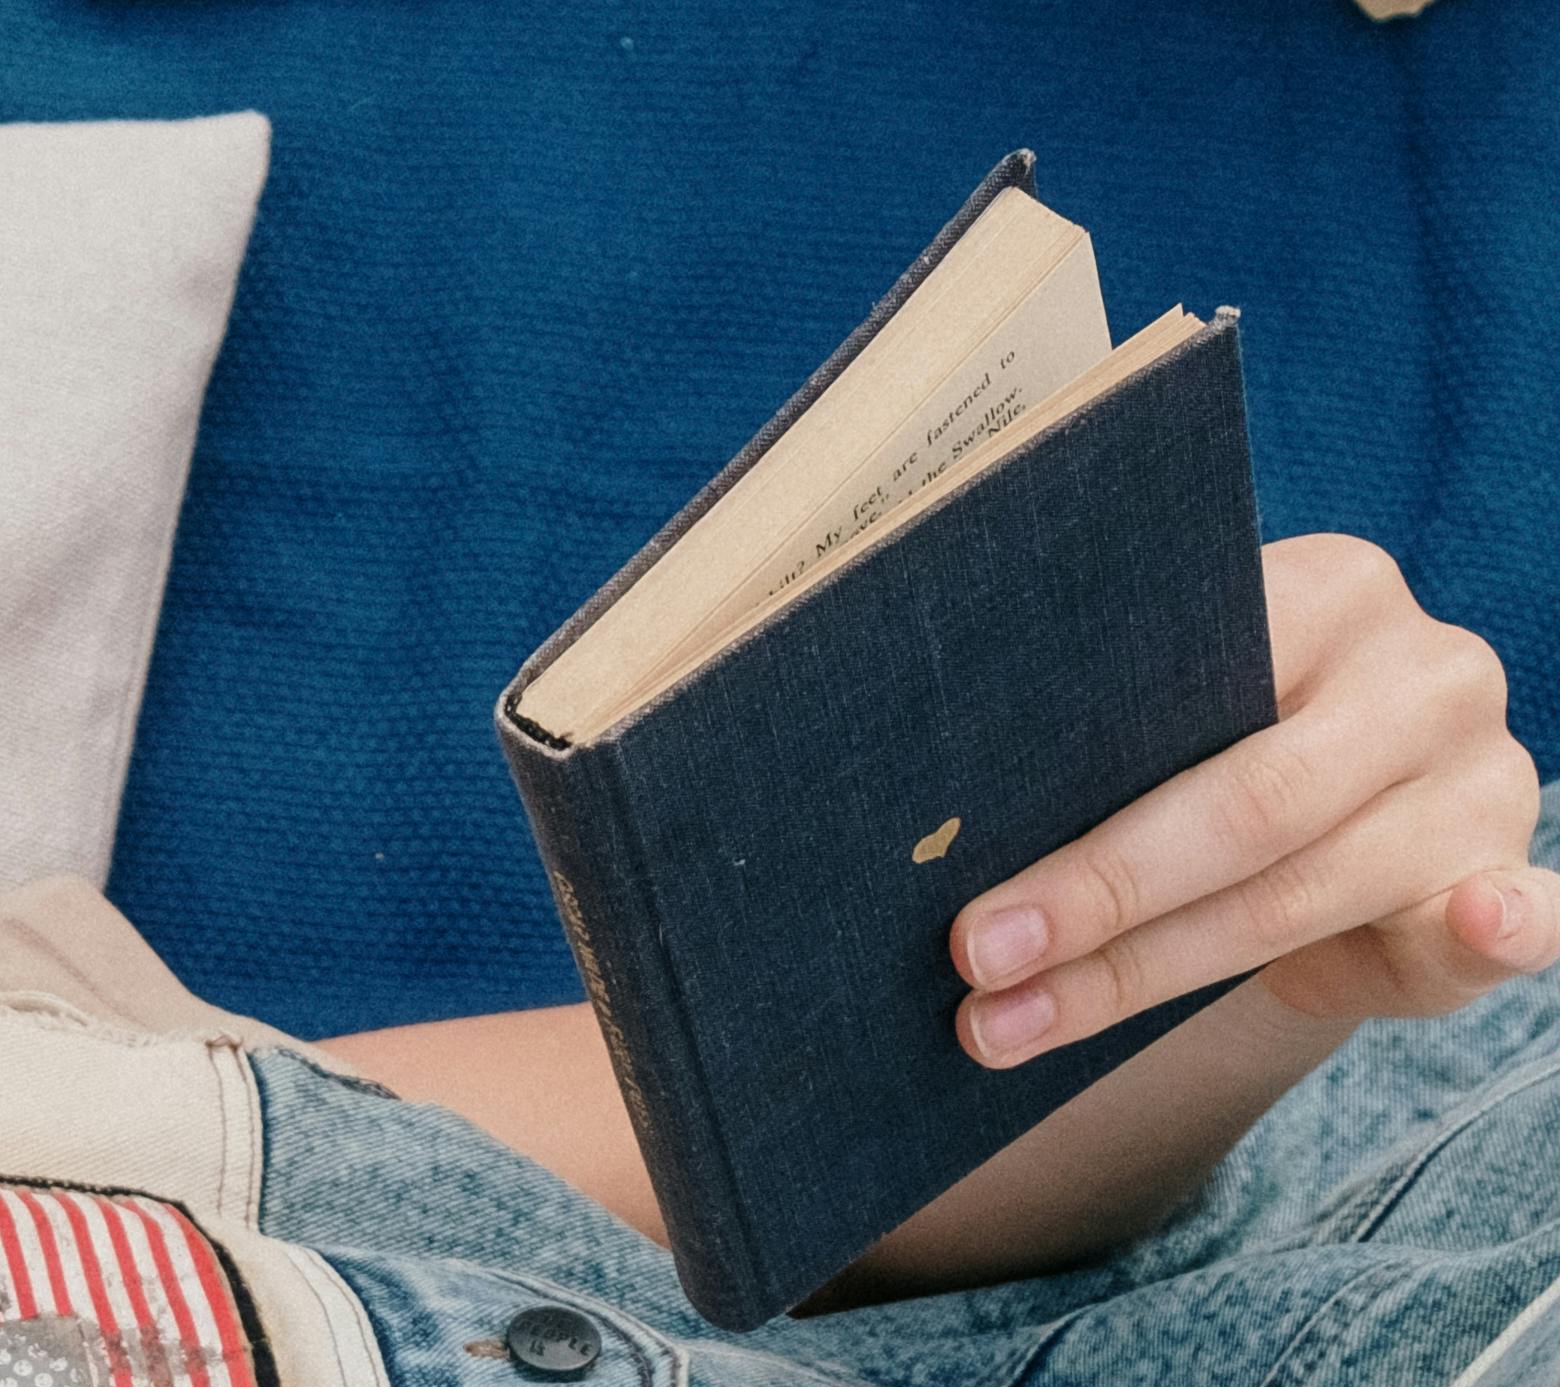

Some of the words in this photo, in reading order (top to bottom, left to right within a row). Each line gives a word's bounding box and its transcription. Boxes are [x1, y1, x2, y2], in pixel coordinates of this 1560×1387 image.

[816, 527, 842, 557] My
[853, 485, 882, 520] feet
[893, 452, 917, 481] are
[927, 372, 991, 446] fastened
[1000, 351, 1015, 369] to
